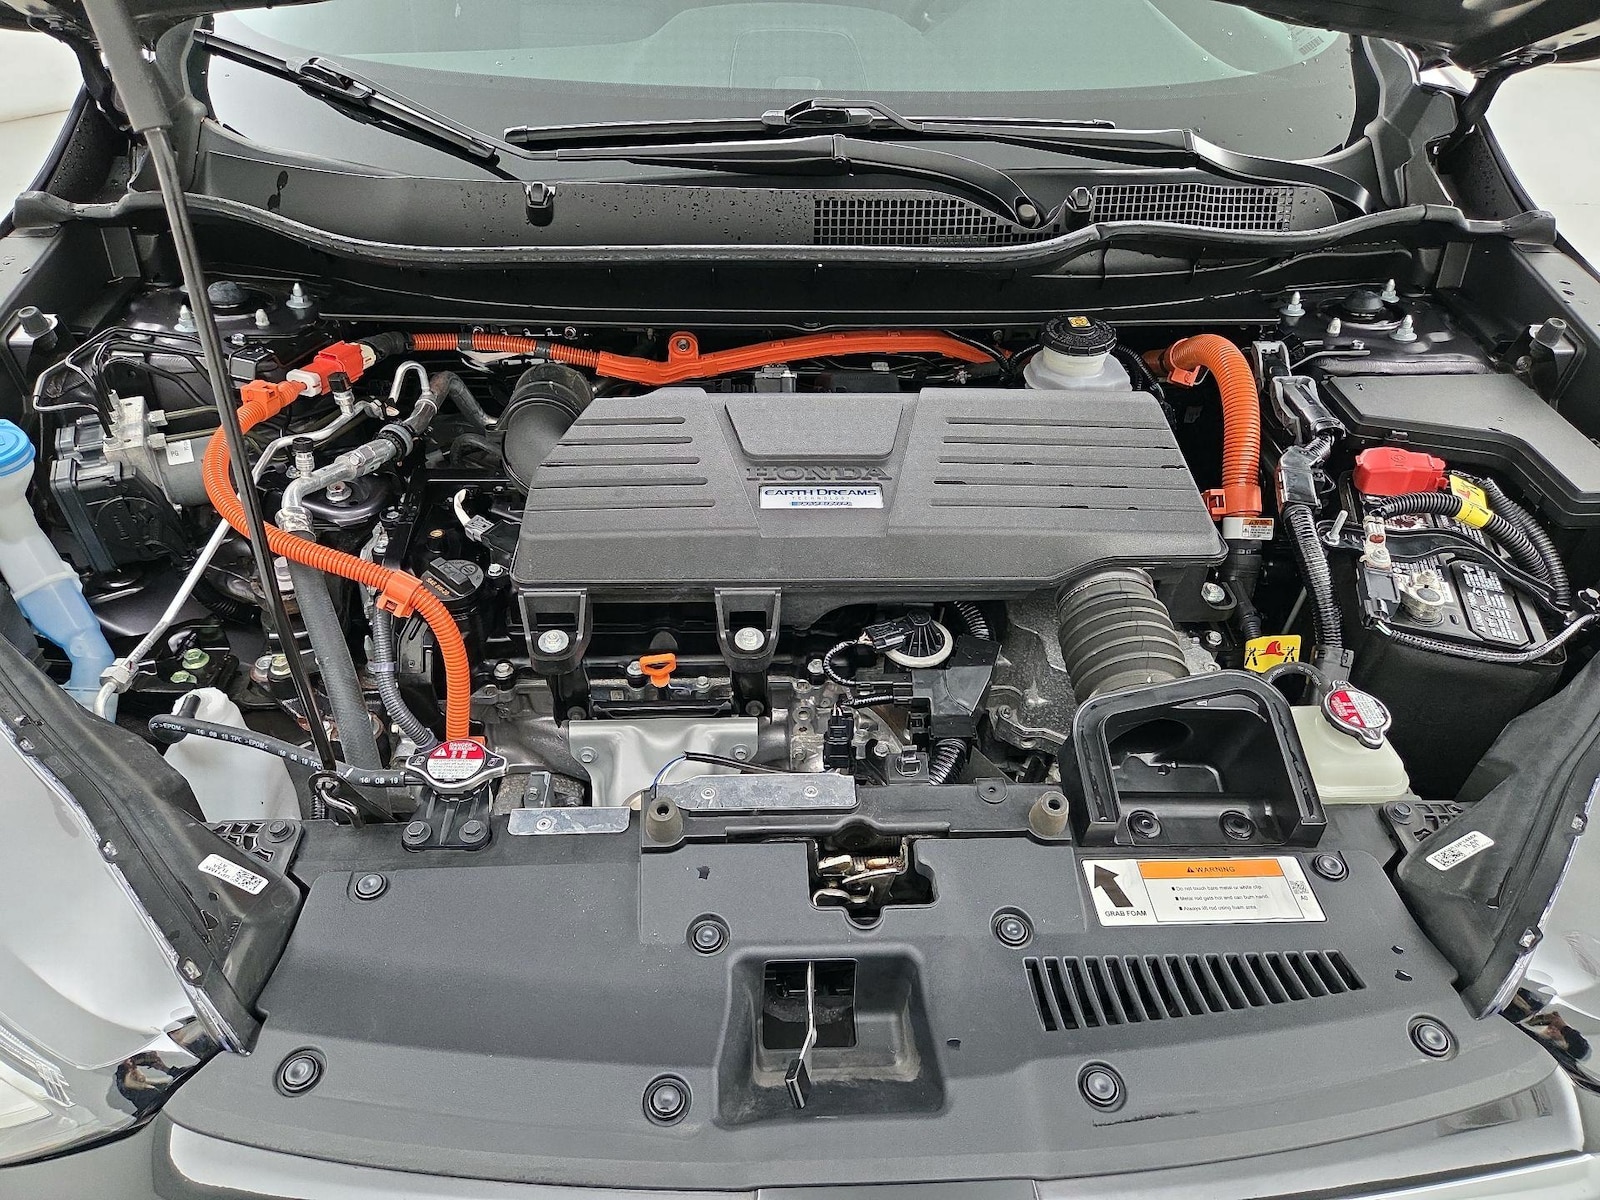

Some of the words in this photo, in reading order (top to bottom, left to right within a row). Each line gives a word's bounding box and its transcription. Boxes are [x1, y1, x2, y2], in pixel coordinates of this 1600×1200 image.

[746, 465, 893, 481] HONDA
[764, 488, 813, 496] EARTH
[816, 488, 877, 496] DREAMS
[231, 735, 243, 743] TPC
